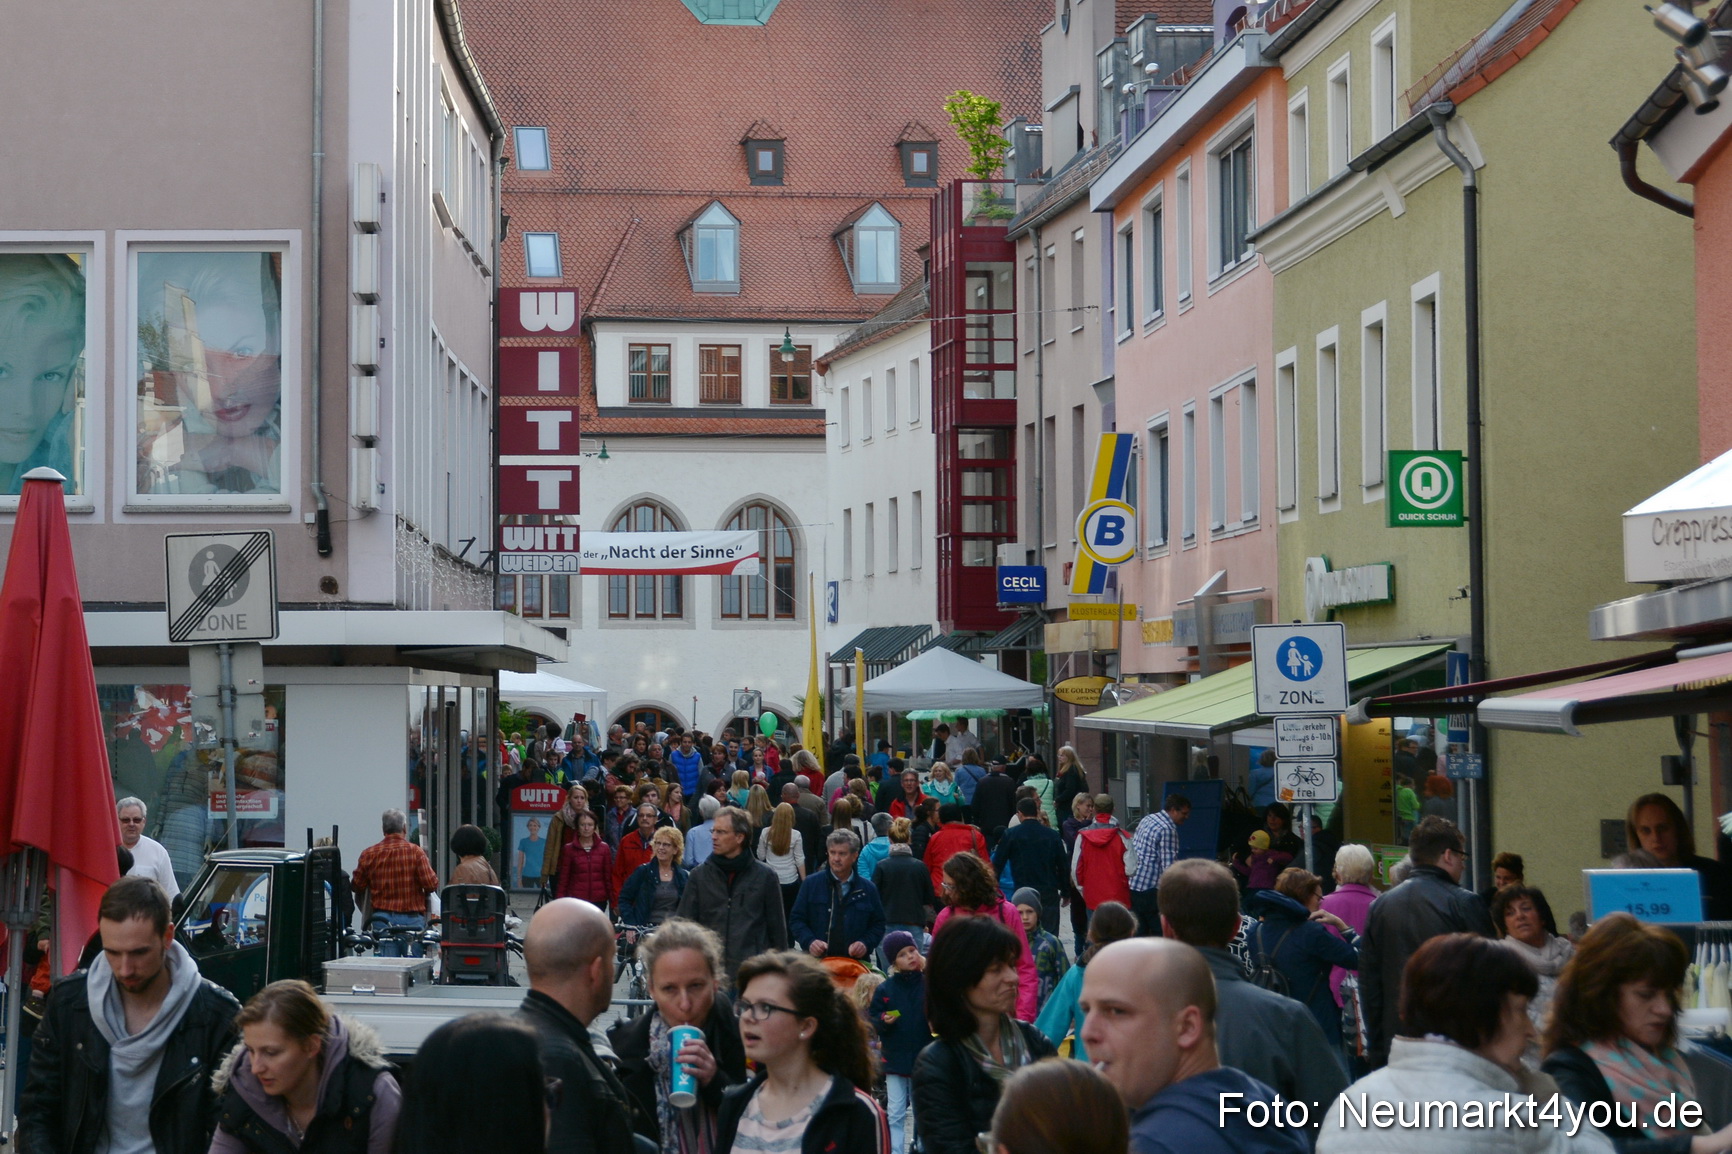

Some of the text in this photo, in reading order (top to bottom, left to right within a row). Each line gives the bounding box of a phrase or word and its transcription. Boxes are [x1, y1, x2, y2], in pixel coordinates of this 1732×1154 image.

[519, 291, 575, 511] WITT
[1398, 512, 1457, 521] QUICK SCHUH
[1094, 514, 1126, 546] B
[502, 526, 577, 551] WITT
[583, 550, 598, 559] der
[660, 545, 688, 559] der
[1003, 576, 1041, 588] CECIL
[1298, 743, 1314, 752] frei
[520, 788, 560, 803] WITT
[1297, 788, 1316, 798] frei
[1625, 902, 1671, 918] 15,99
